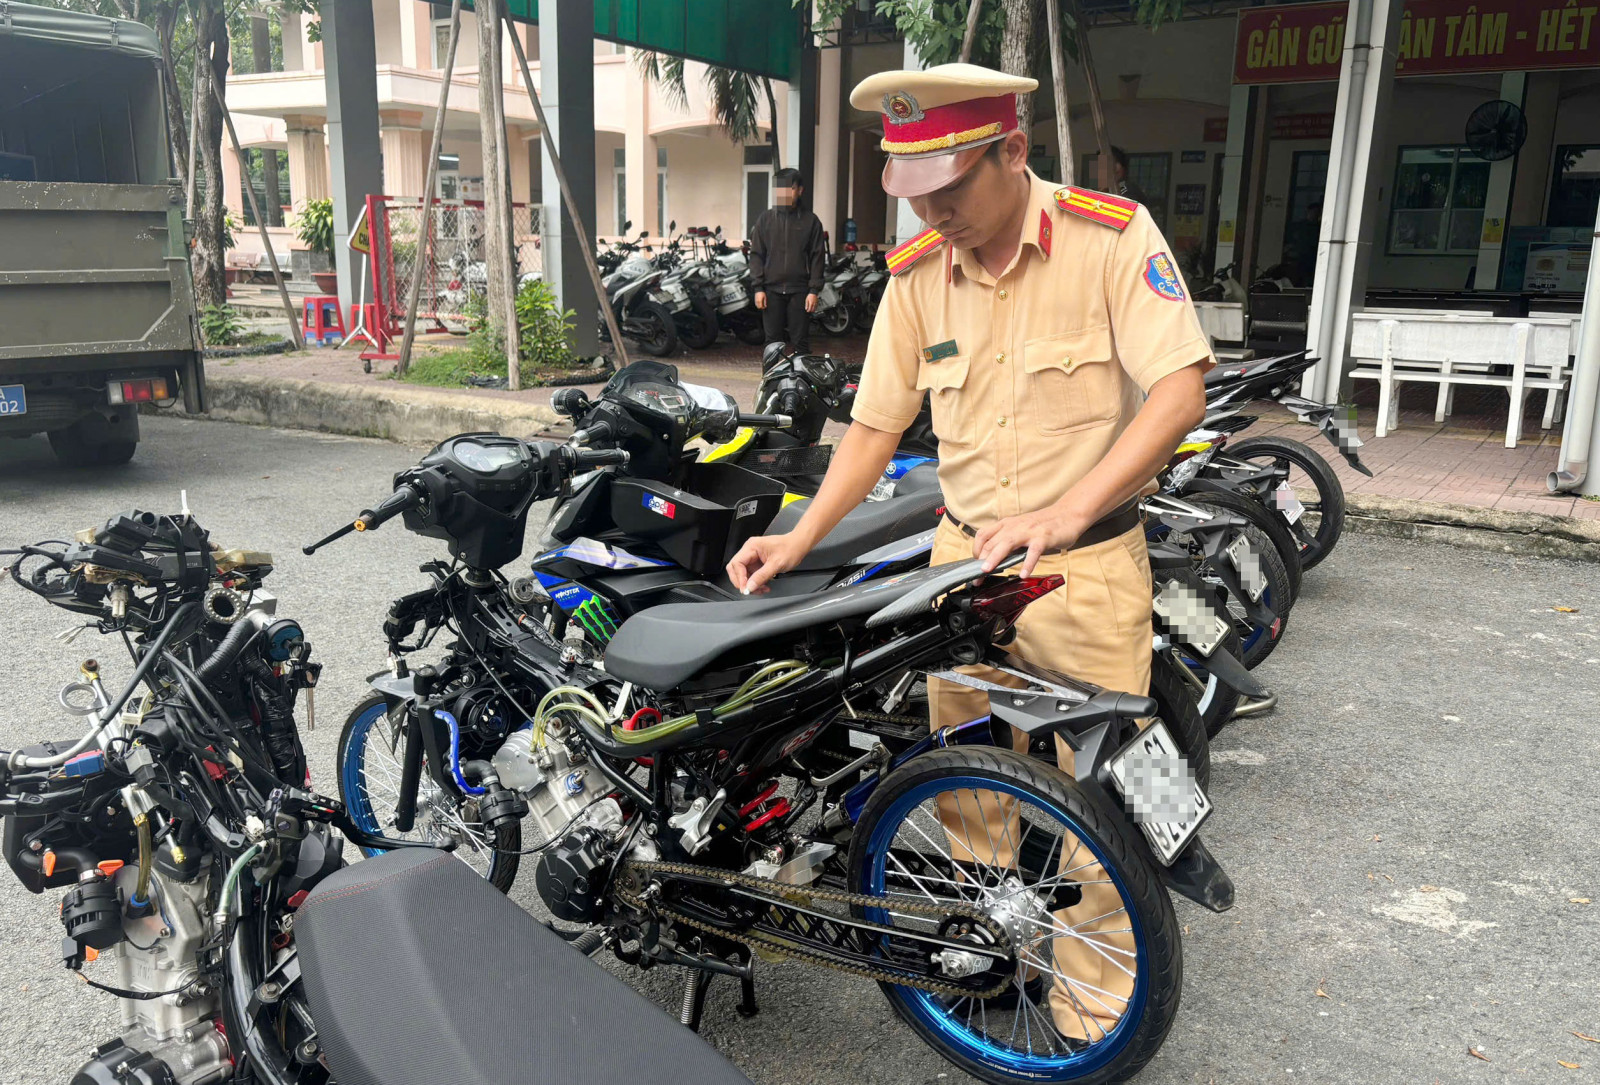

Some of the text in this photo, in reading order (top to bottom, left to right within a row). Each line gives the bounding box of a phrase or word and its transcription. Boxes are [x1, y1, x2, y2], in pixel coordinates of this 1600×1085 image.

[1246, 14, 1300, 69] GẦN
[1307, 16, 1345, 66] GŨ
[1396, 10, 1436, 70] ẬN
[1445, 5, 1509, 57] TÂM
